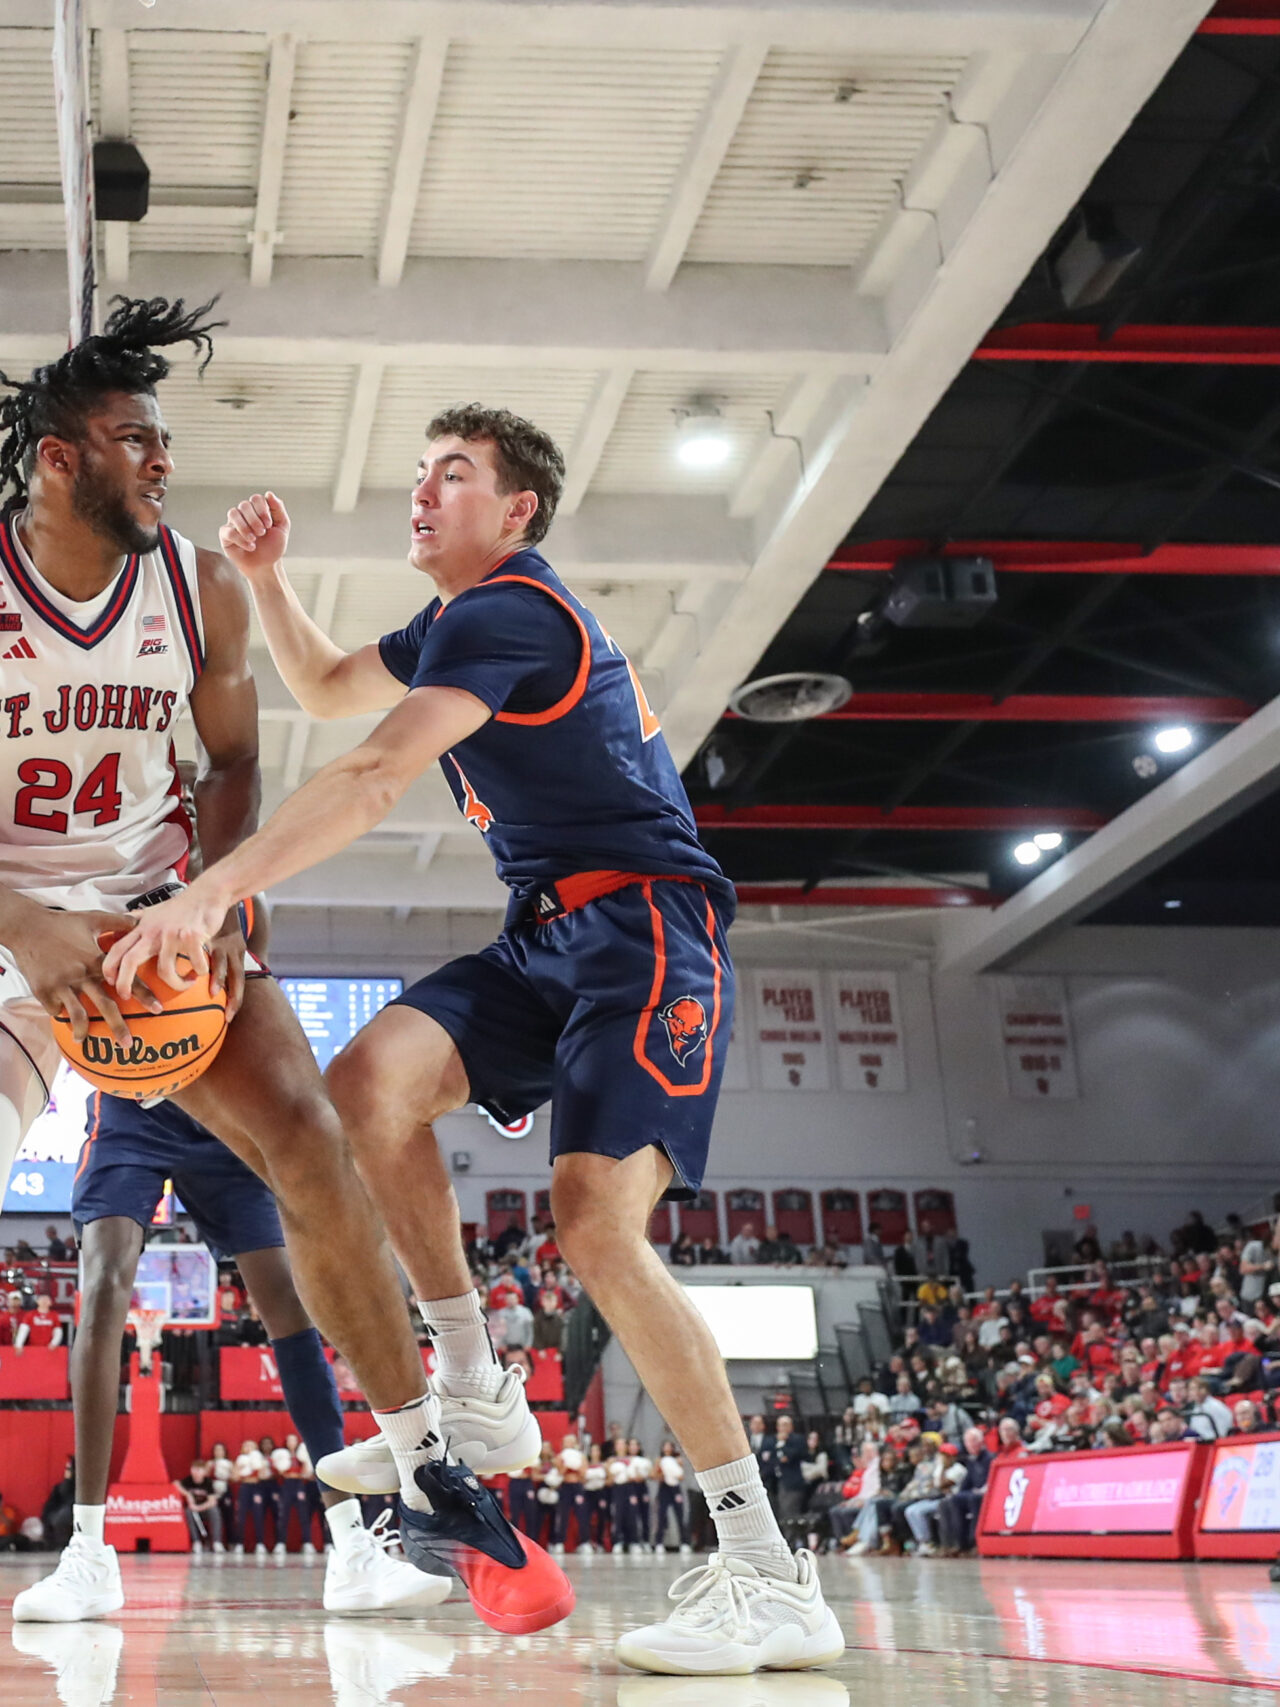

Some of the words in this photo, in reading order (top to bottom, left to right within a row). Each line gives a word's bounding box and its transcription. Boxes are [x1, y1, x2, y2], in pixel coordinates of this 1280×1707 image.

[139, 645, 168, 655] EAST
[141, 638, 163, 647] BIG
[43, 684, 177, 734] JOHN'S
[14, 752, 122, 834] 24
[763, 988, 813, 1007] PLAYER
[839, 989, 891, 1009] PLAYER
[82, 1034, 200, 1066] Wilson
[10, 1172, 45, 1196] 43
[106, 1494, 183, 1514] Maspeth
